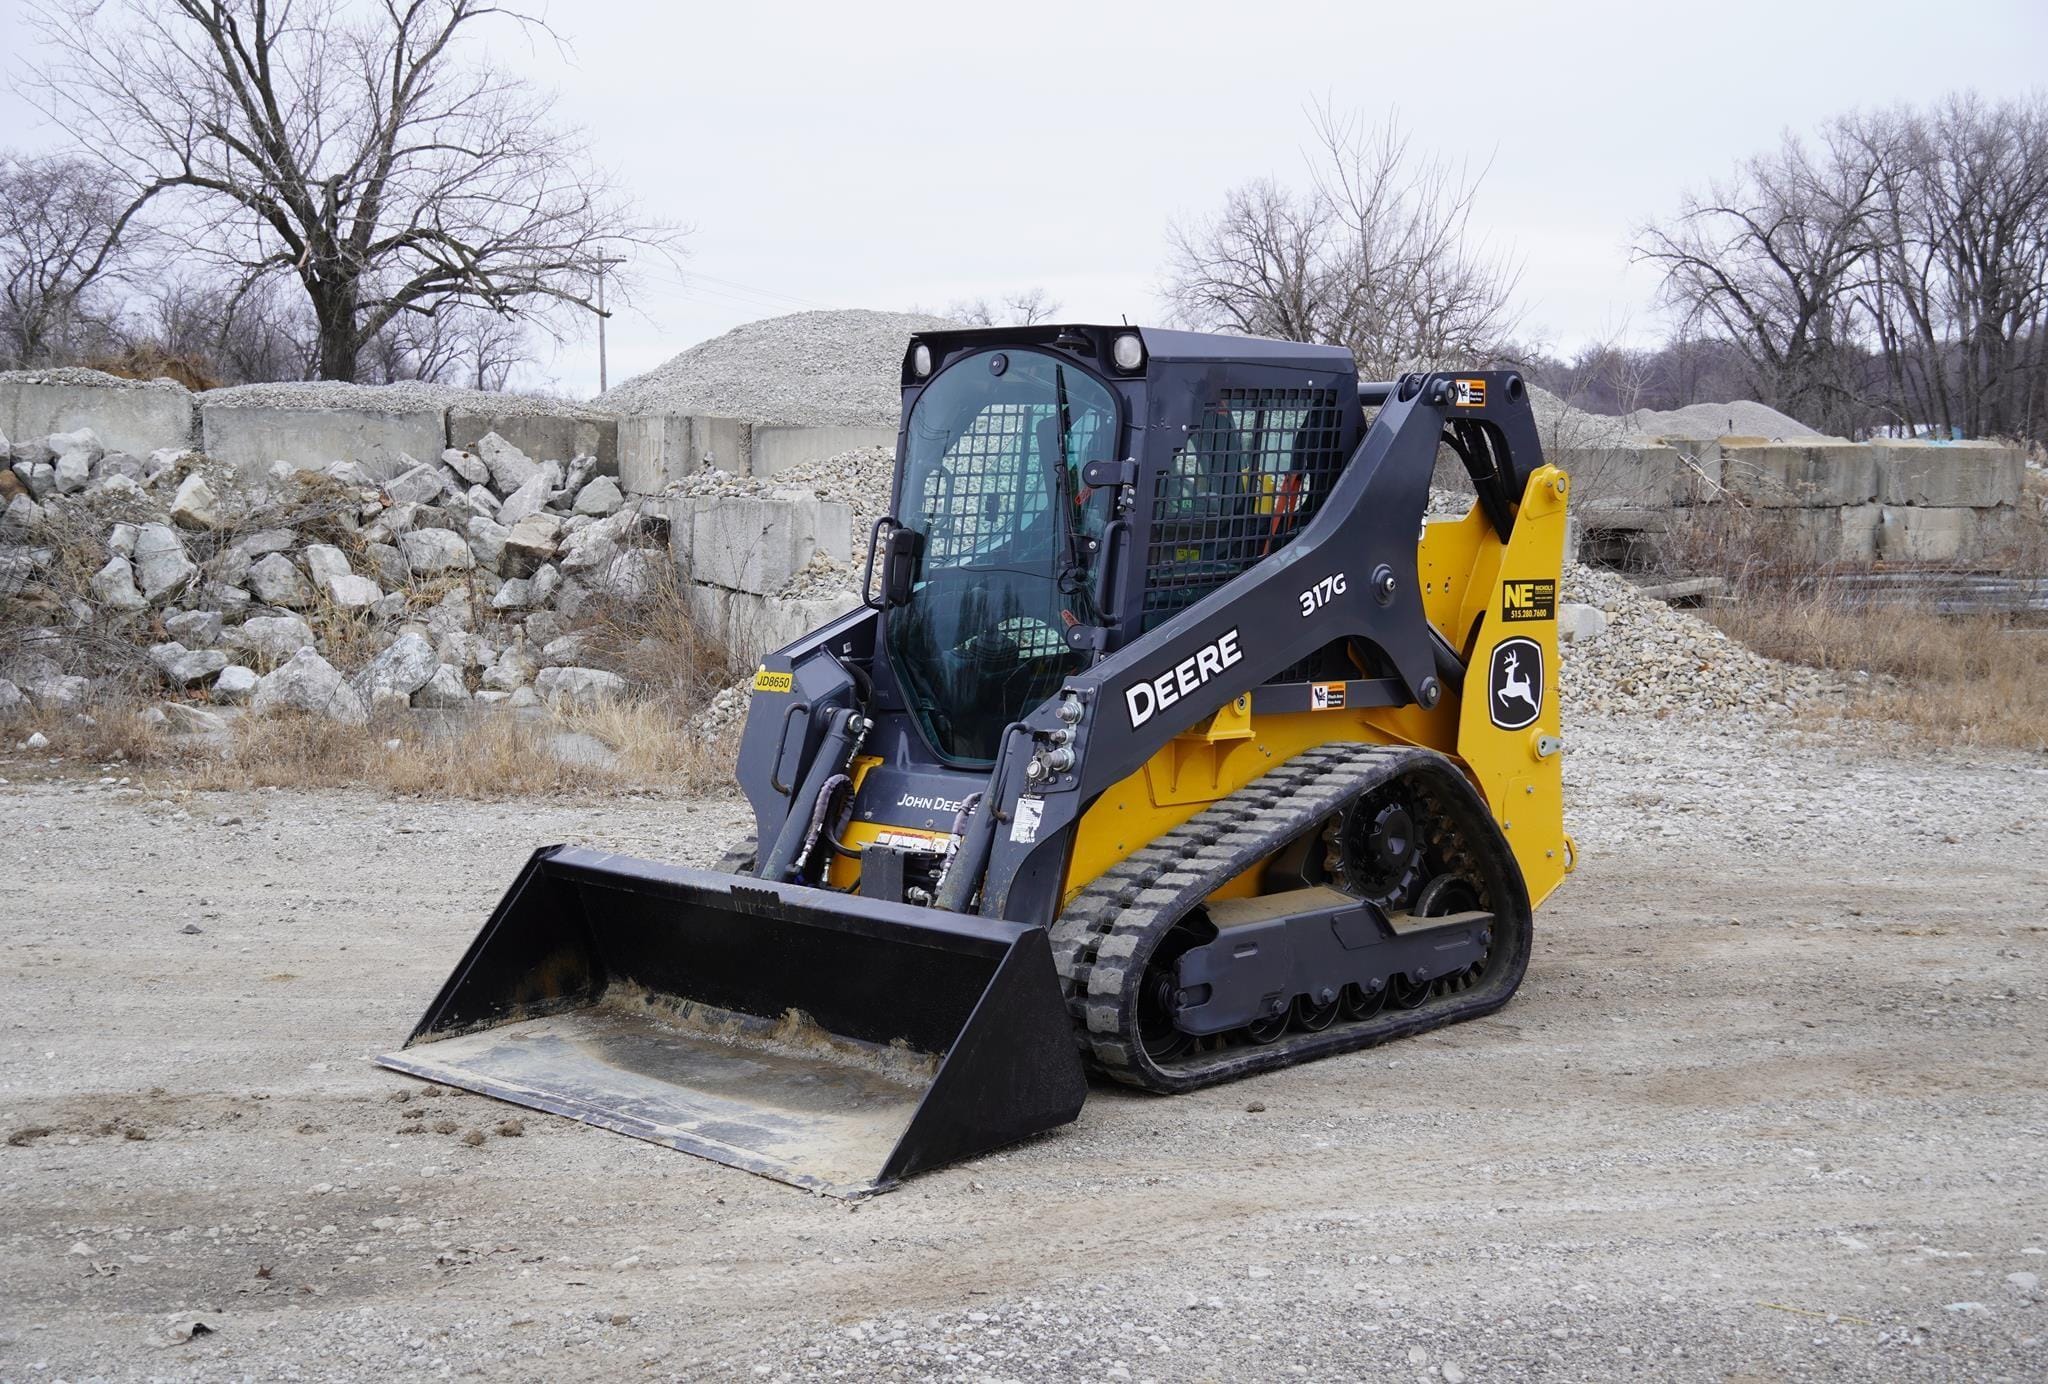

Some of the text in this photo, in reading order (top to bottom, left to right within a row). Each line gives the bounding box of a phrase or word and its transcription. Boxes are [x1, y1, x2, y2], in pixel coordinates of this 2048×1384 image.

[1300, 573, 1347, 616] 317G
[1504, 584, 1534, 608] NE
[757, 675, 790, 688] JD8650
[1125, 629, 1243, 728] DEERE
[897, 794, 933, 810] JOHN
